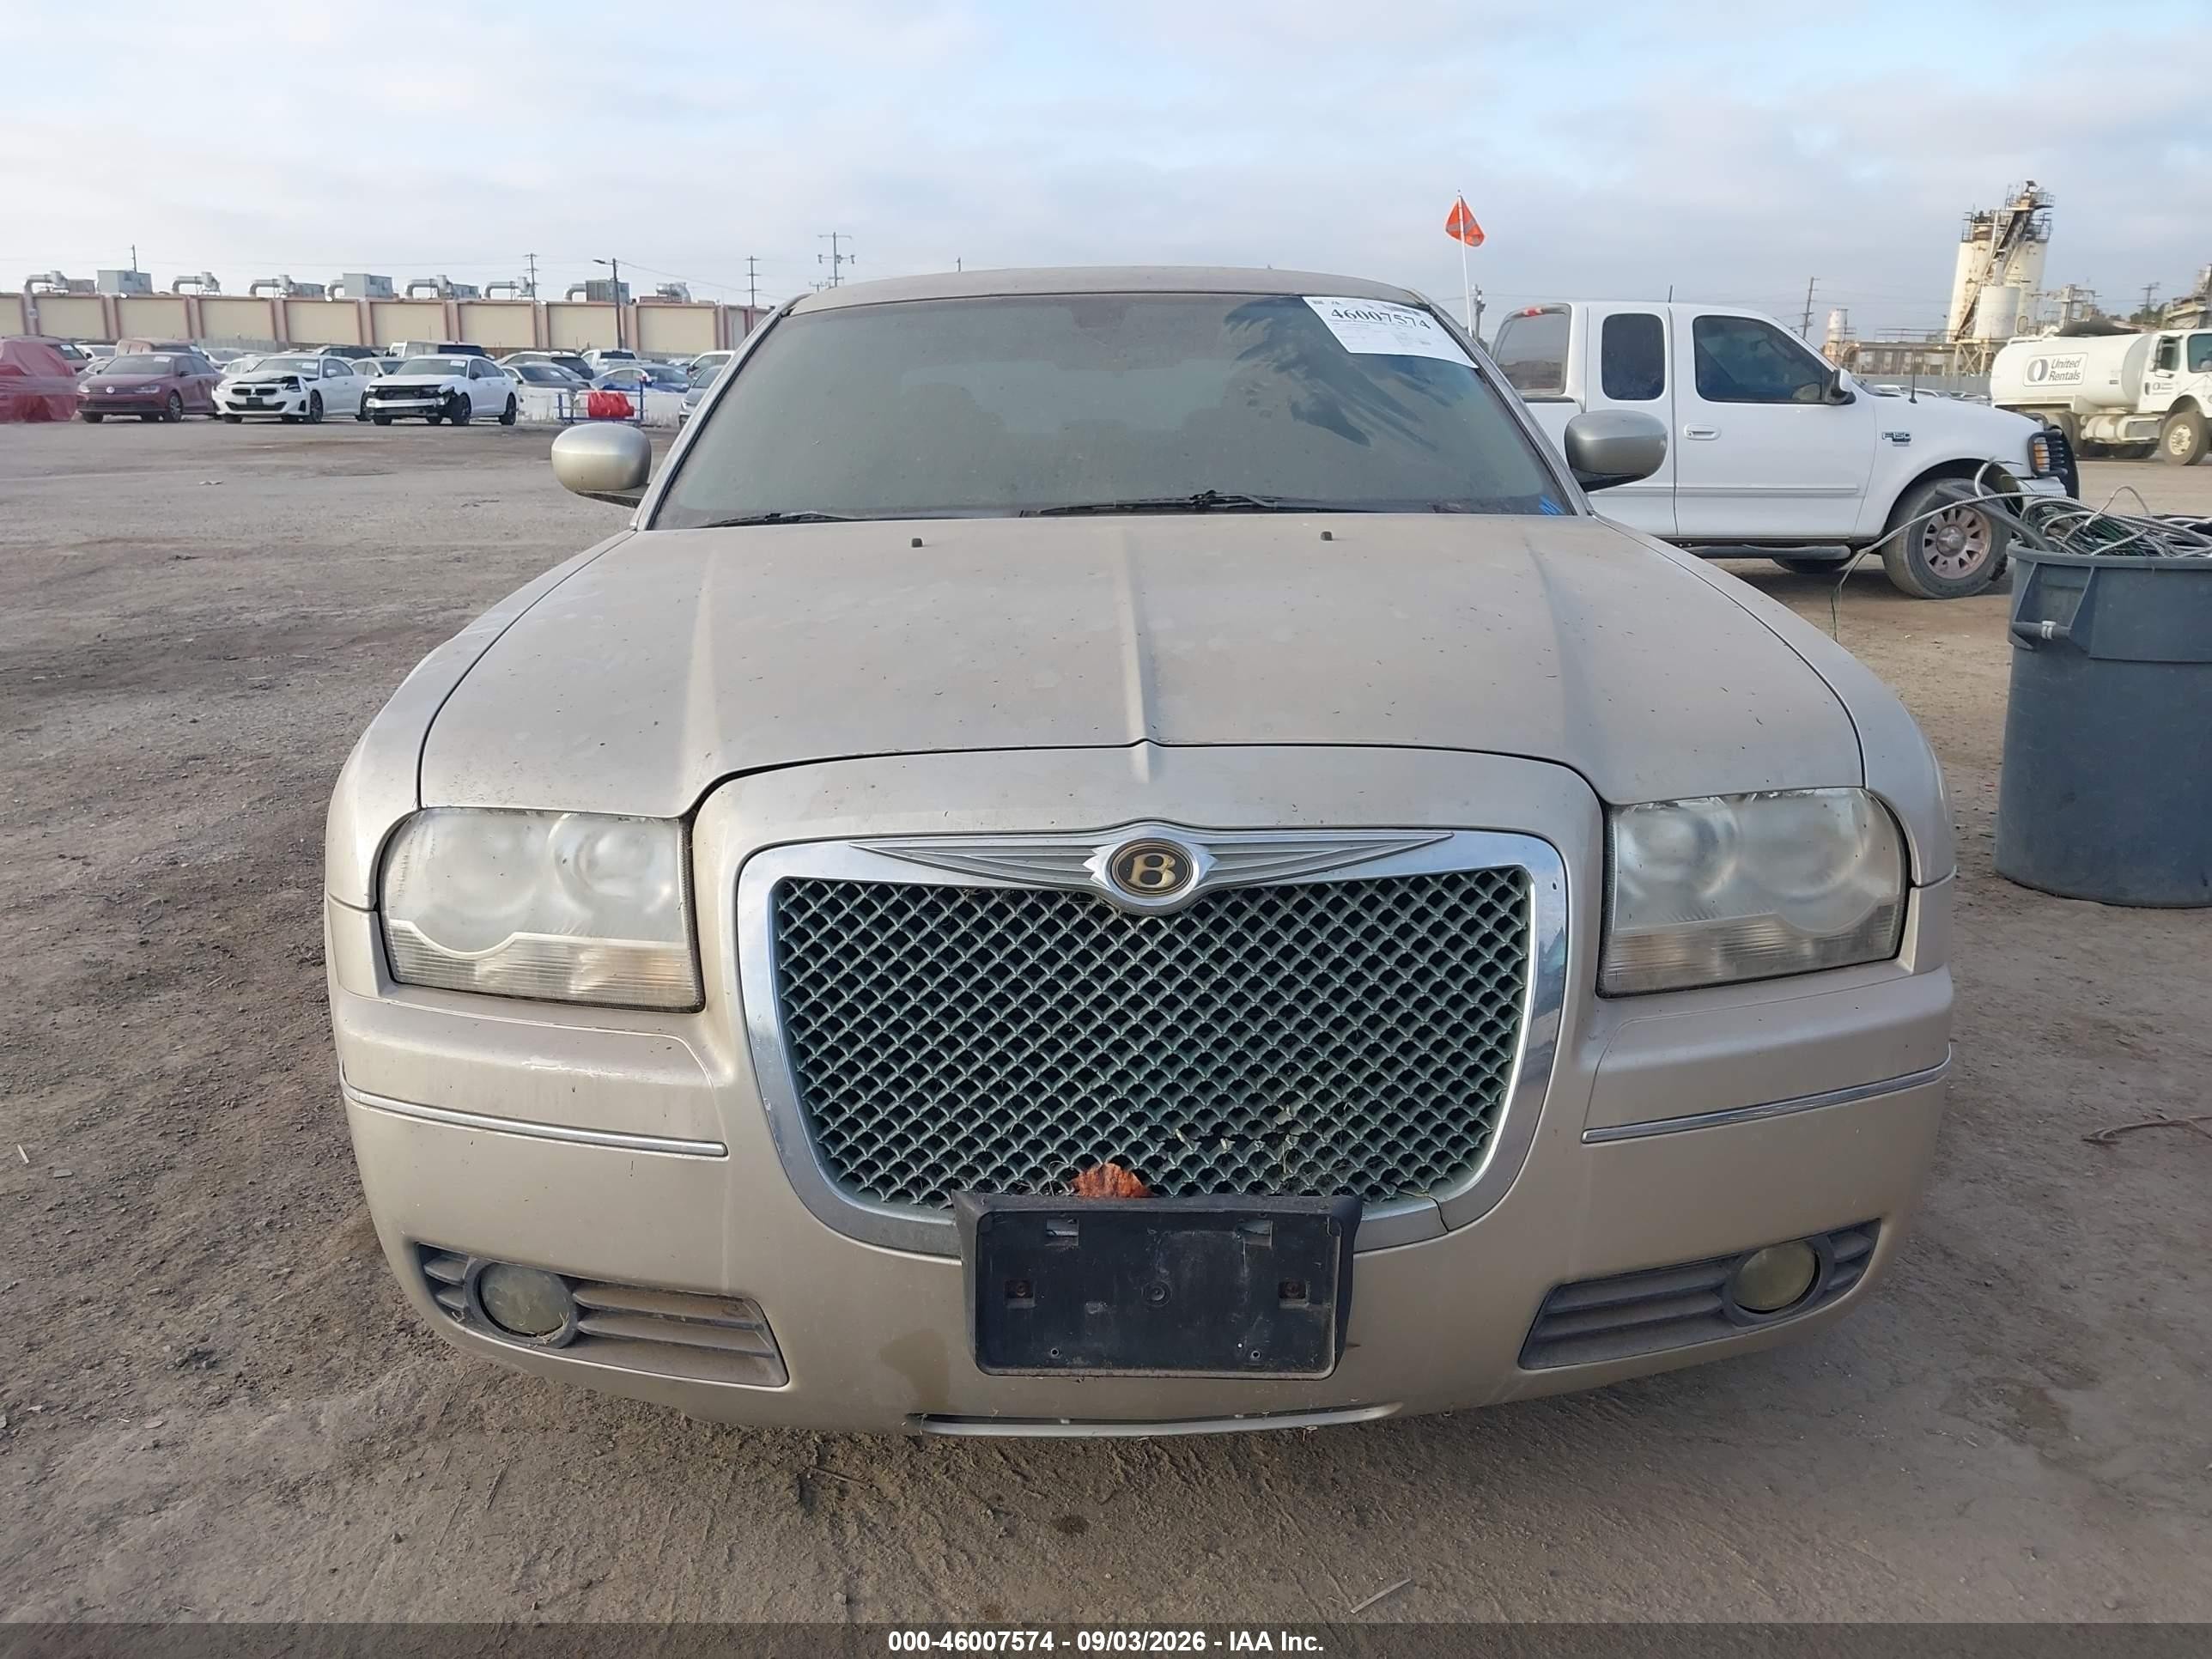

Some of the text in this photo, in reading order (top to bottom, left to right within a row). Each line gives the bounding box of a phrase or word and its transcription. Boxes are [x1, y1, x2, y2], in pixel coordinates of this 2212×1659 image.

[1330, 308, 1431, 331] 46007574
[2051, 356, 2082, 368] United
[2048, 368, 2081, 382] Rentals
[1127, 852, 1177, 889] B
